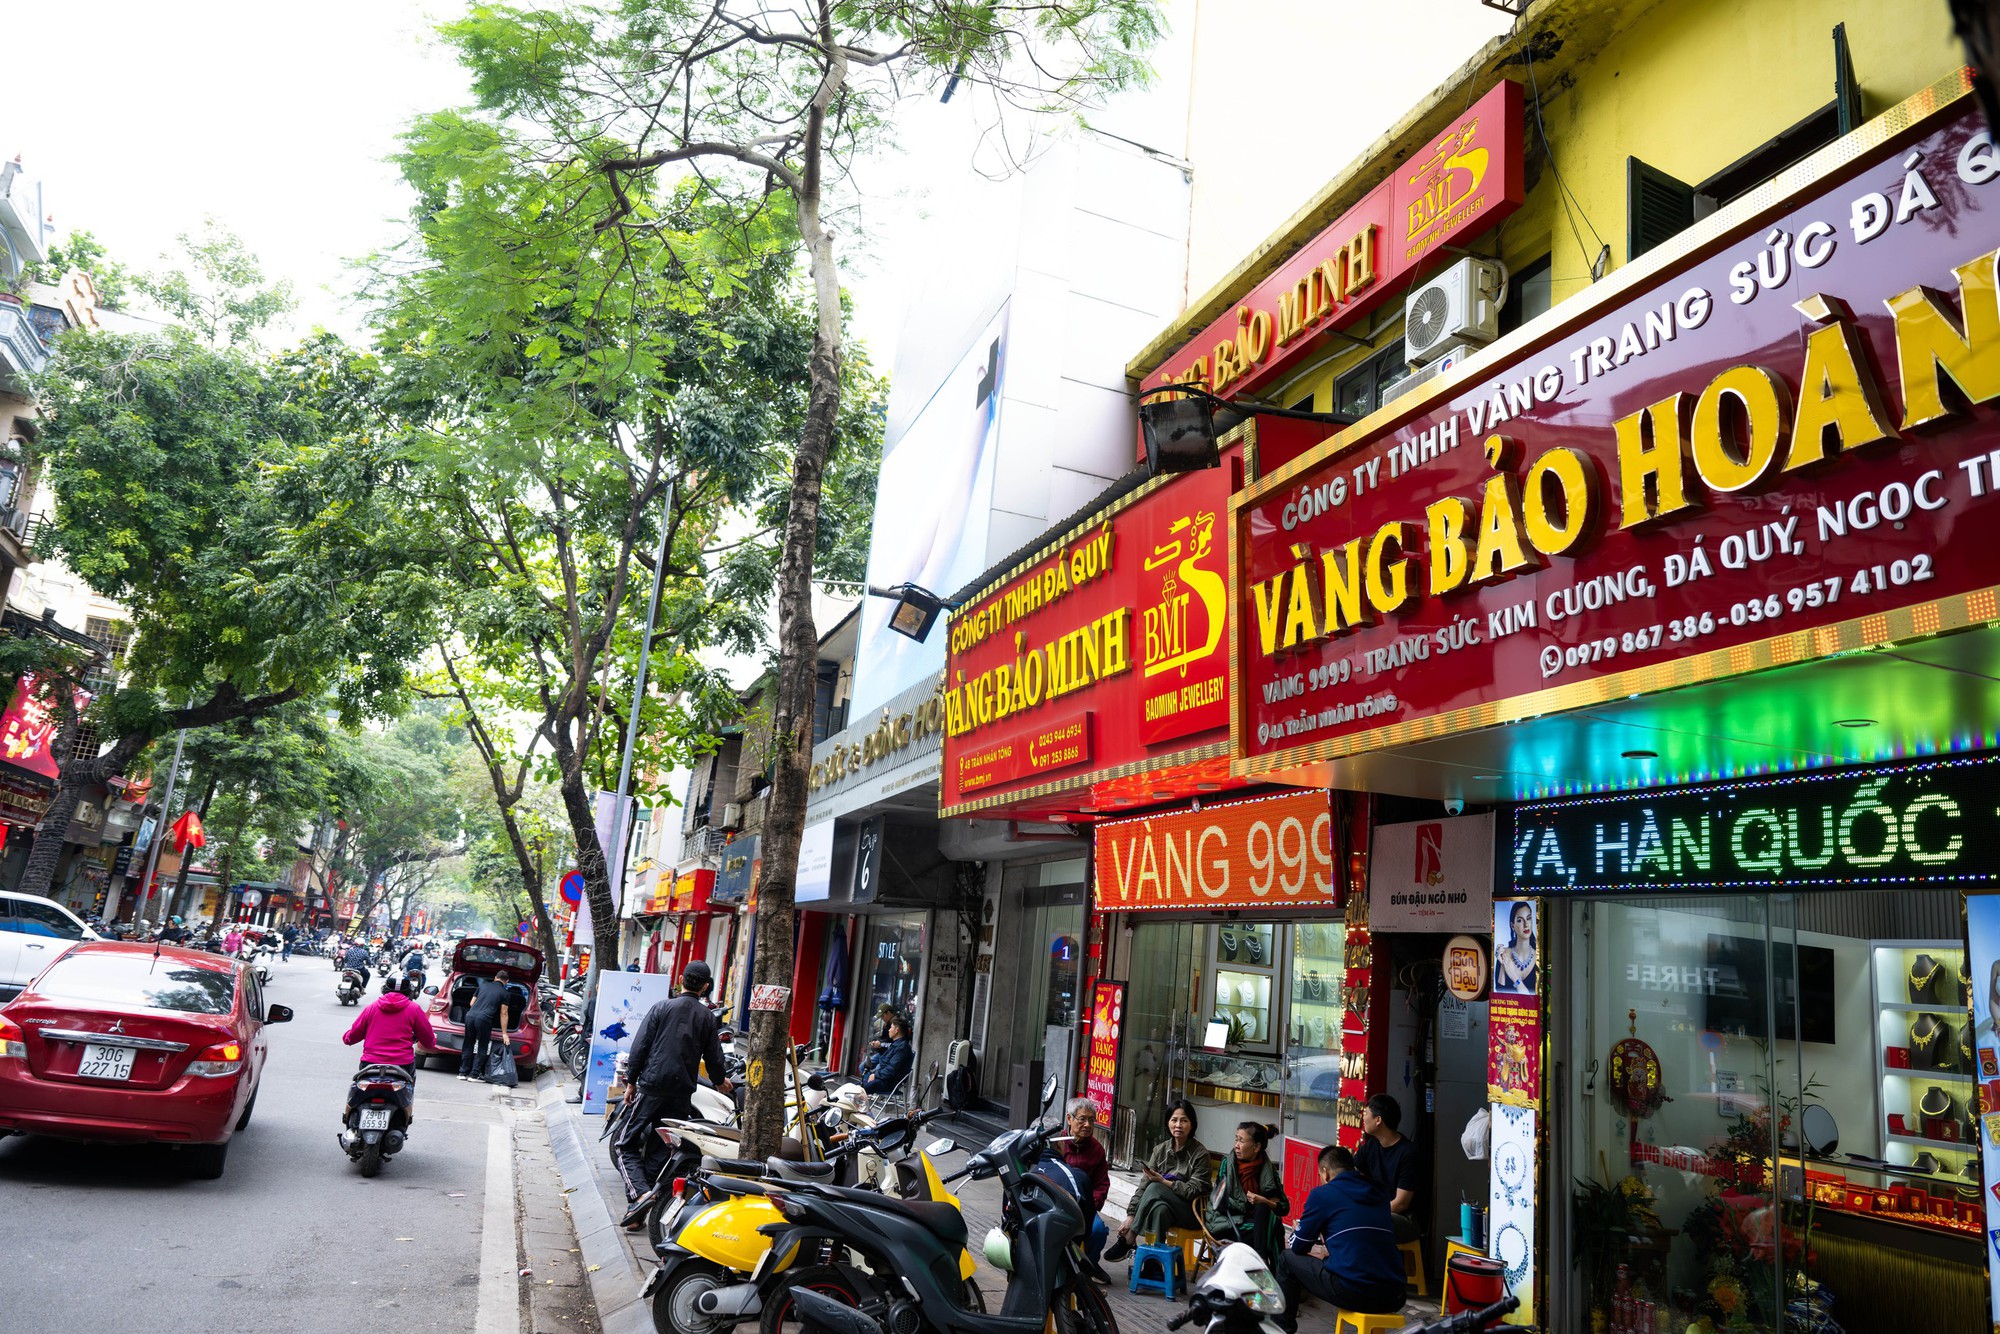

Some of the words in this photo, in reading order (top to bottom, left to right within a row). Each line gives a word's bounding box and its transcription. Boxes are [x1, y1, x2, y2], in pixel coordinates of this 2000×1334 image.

[1406, 228, 1440, 261] BAOMINH
[1441, 194, 1486, 236] JEWELLERY
[1213, 305, 1272, 394] BẢO
[1275, 223, 1377, 349] MINH
[1282, 476, 1347, 531] CÔNG
[1353, 456, 1382, 496] TY
[1388, 415, 1460, 478] TNHH
[1467, 365, 1562, 436] VÀNG
[1570, 287, 1711, 386] TRANG
[1729, 221, 1837, 305] SỨC
[1850, 151, 1942, 245] ĐÁ
[1250, 521, 1412, 657] VÀNG
[1425, 433, 1594, 598] BẢO
[952, 610, 988, 656] CÔNG
[989, 598, 1004, 635] TY
[1005, 574, 1044, 624] TNHH
[1044, 548, 1072, 603] ĐÁ
[1071, 519, 1116, 585] QUÝ
[1262, 673, 1305, 705] VÀNG
[1308, 657, 1351, 692] 9999
[1364, 634, 1430, 676] TRANG
[1436, 614, 1482, 655] SỨC
[1488, 600, 1538, 641] KIM
[1545, 565, 1656, 621] CƯƠNG,
[1663, 534, 1714, 588] ĐÁ
[1720, 505, 1804, 569] QUÝ,
[1817, 470, 1949, 542] NGỌC
[1565, 636, 1617, 667] 0979
[1622, 624, 1663, 654] 867
[1787, 576, 1842, 612] 957
[1851, 553, 1934, 595] 4102
[945, 670, 995, 738] VÀNG
[996, 631, 1046, 719] BẢO
[1046, 606, 1132, 700] MINH
[1146, 690, 1178, 722] BAOMINH
[1179, 676, 1225, 712] JEWELLERY
[1269, 724, 1285, 739] 4A
[1286, 709, 1316, 736] TRẦN
[1319, 703, 1355, 729] NHÂN
[1356, 694, 1398, 720] TÔNG
[862, 707, 913, 767] ĐỒNG
[1039, 732, 1053, 747] 0243
[1054, 728, 1066, 742] 944
[1066, 723, 1082, 738] 6934
[983, 748, 997, 764] NHÂN
[998, 745, 1012, 760] TÔNG
[1051, 750, 1062, 764] 253
[964, 772, 992, 788] www.bmj.vn
[1596, 809, 1711, 874] HÀN
[1731, 777, 1963, 876] QUỐC
[1111, 820, 1230, 901] VÀNG
[1390, 891, 1408, 905] BÚN
[1408, 891, 1427, 907] ĐẬU
[1428, 890, 1446, 904] NGÕ
[1447, 888, 1467, 904] NHỎ
[878, 942, 897, 959] STYLE
[1452, 950, 1478, 969] Bún
[1453, 968, 1477, 988] Đậu
[96, 1047, 124, 1062] 30G
[1095, 1040, 1114, 1056] VÀNG
[80, 1061, 130, 1078] 227.15
[1090, 1055, 1115, 1078] 9999
[362, 1120, 387, 1129] 855.93
